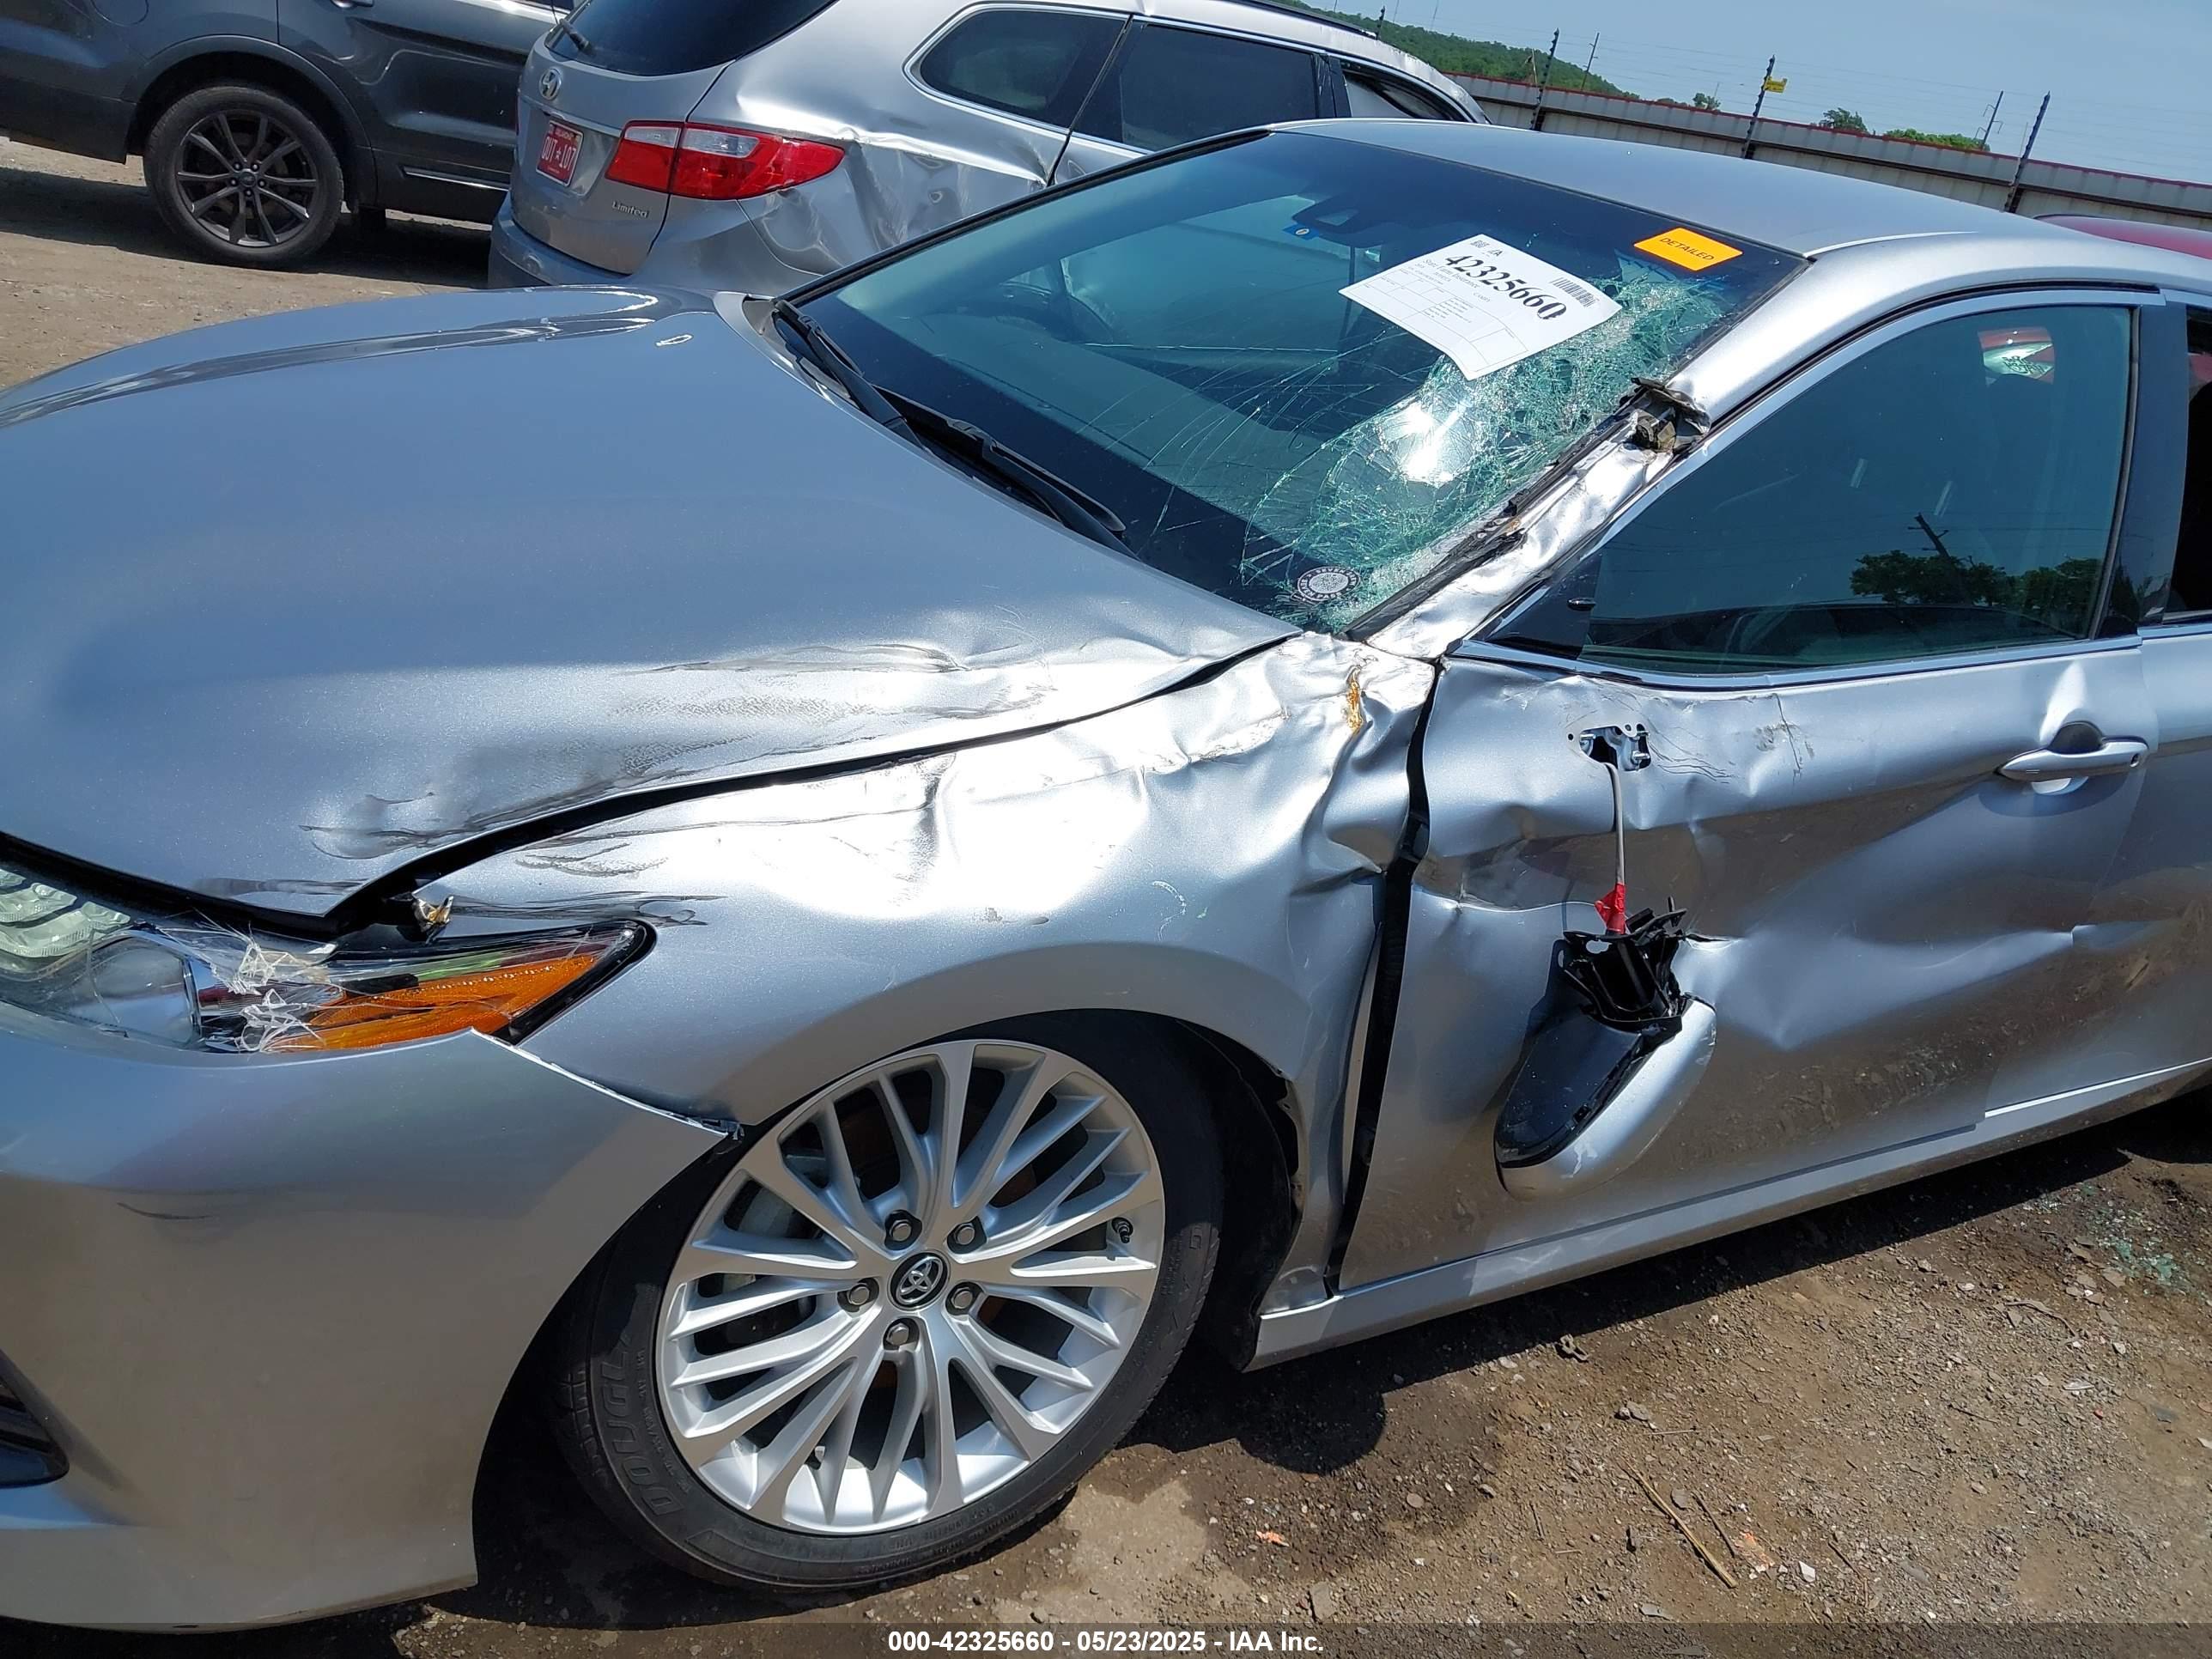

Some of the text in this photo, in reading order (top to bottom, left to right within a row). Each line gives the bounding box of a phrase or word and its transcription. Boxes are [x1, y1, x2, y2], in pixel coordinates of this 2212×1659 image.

[612, 201, 648, 218] Limited
[1660, 237, 1715, 261] DETAILED
[1445, 255, 1567, 320] 42325660
